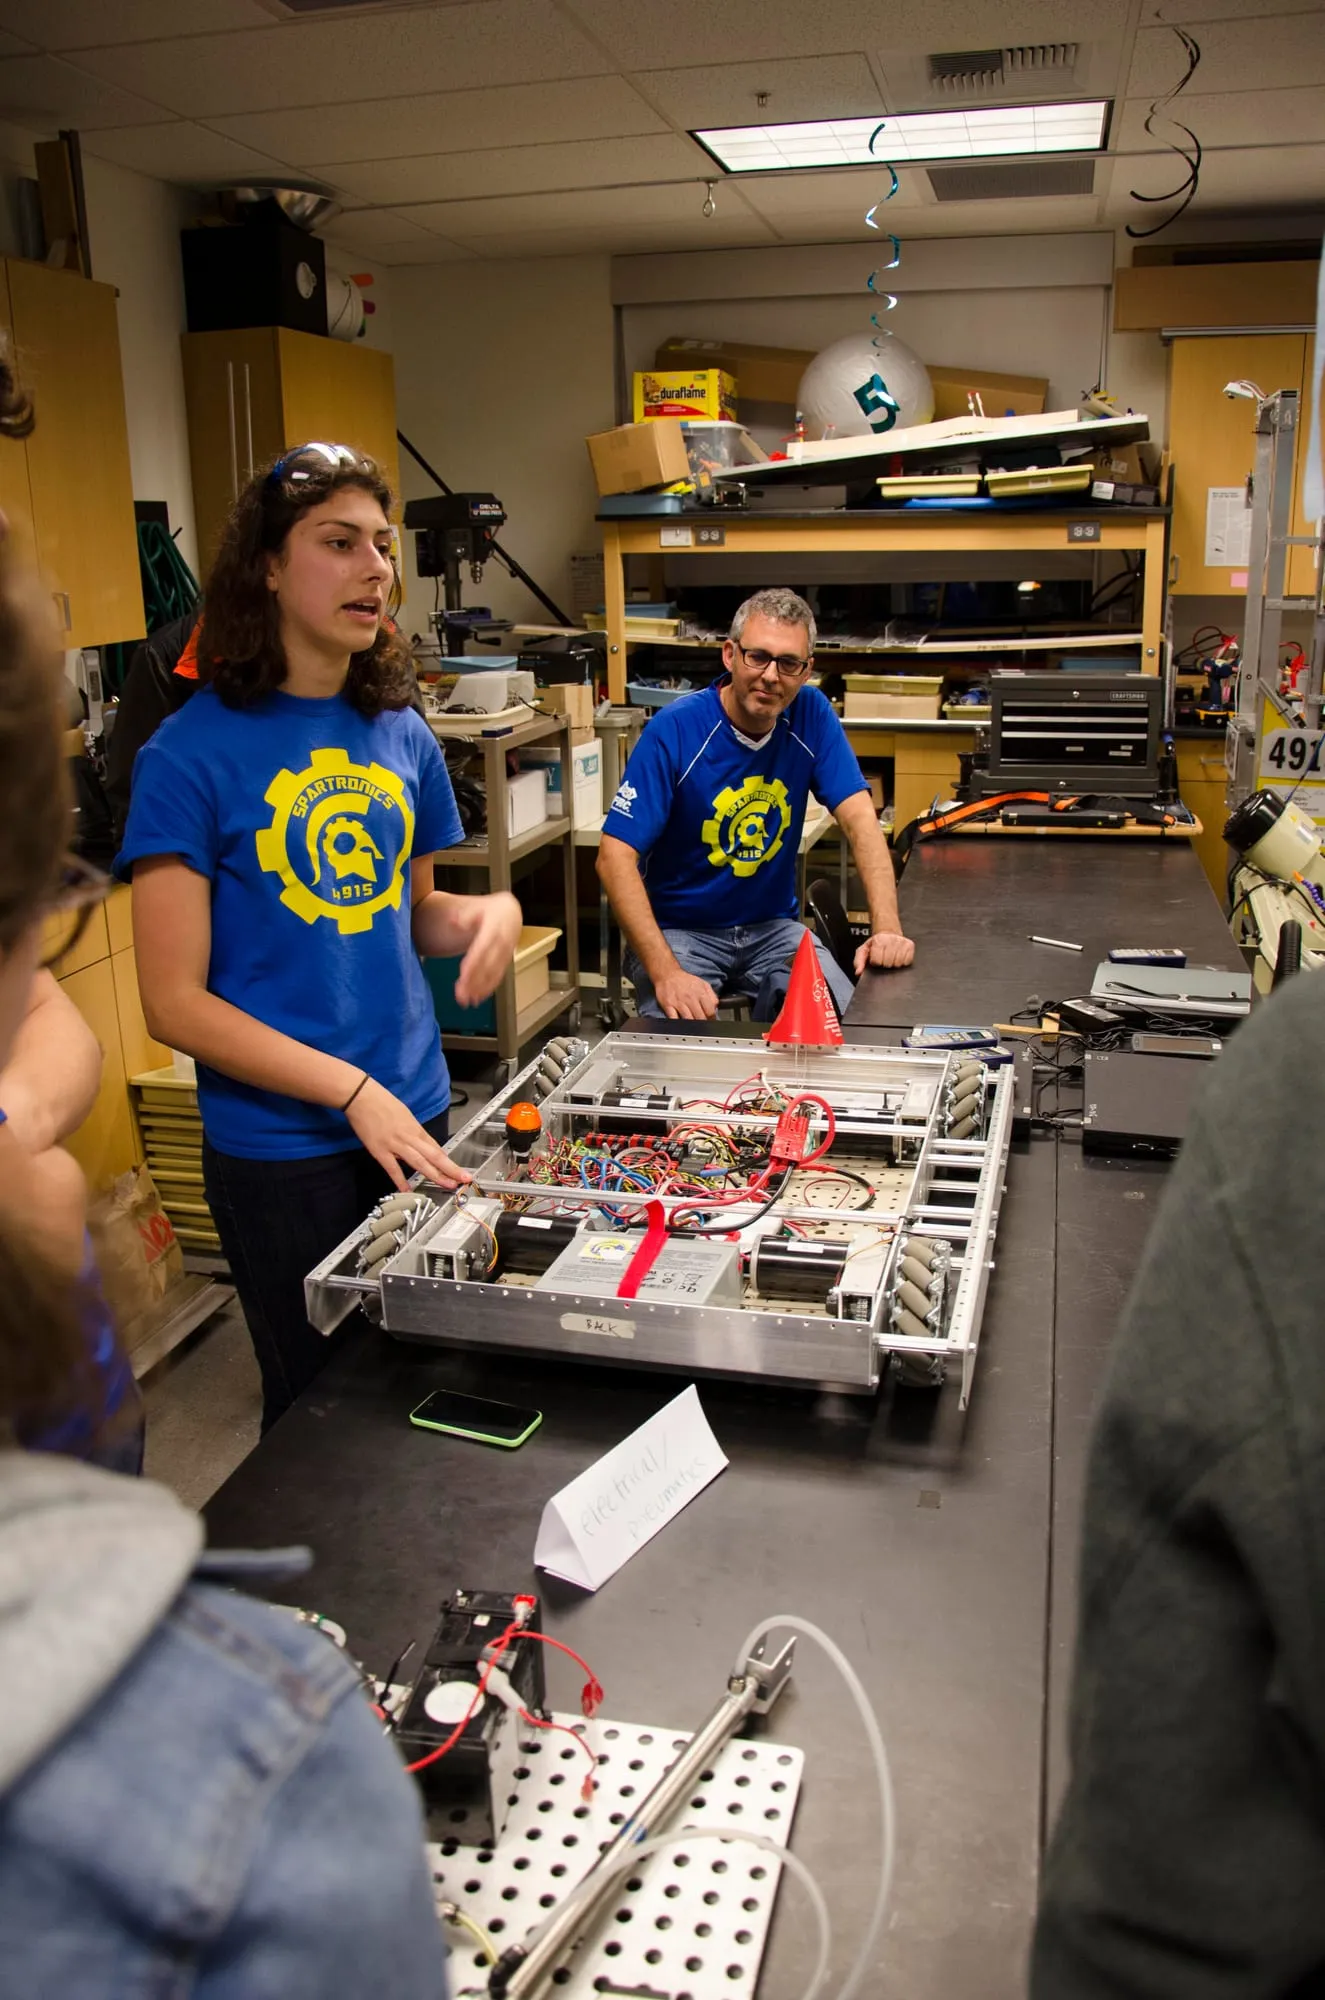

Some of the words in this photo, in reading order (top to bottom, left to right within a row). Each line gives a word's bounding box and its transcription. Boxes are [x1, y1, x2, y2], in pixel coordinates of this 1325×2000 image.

[660, 385, 706, 399] duraflame
[853, 373, 900, 434] 5
[292, 776, 395, 818] SPARTRONICS
[332, 883, 373, 900] 4915
